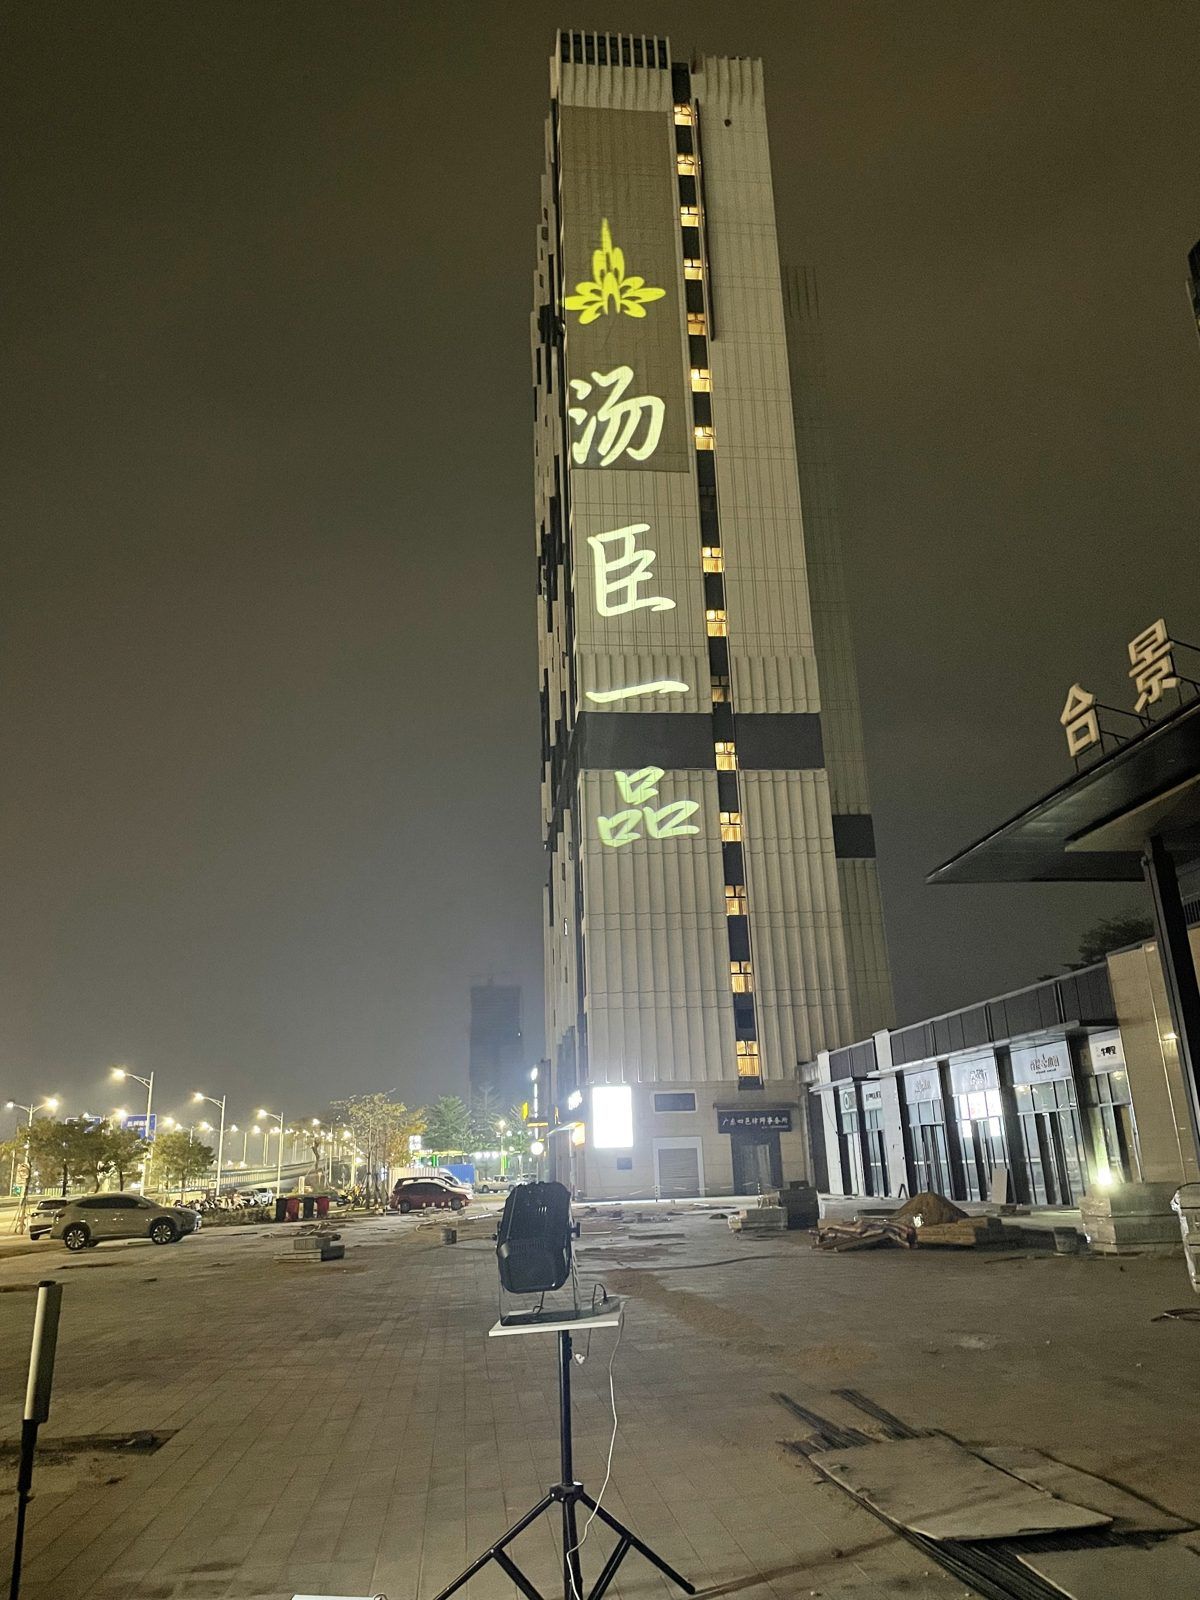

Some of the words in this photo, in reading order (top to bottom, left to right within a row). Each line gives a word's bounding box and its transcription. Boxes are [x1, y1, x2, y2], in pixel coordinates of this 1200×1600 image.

[568, 365, 701, 849] 汤臣一品
[1060, 618, 1182, 758] 合景
